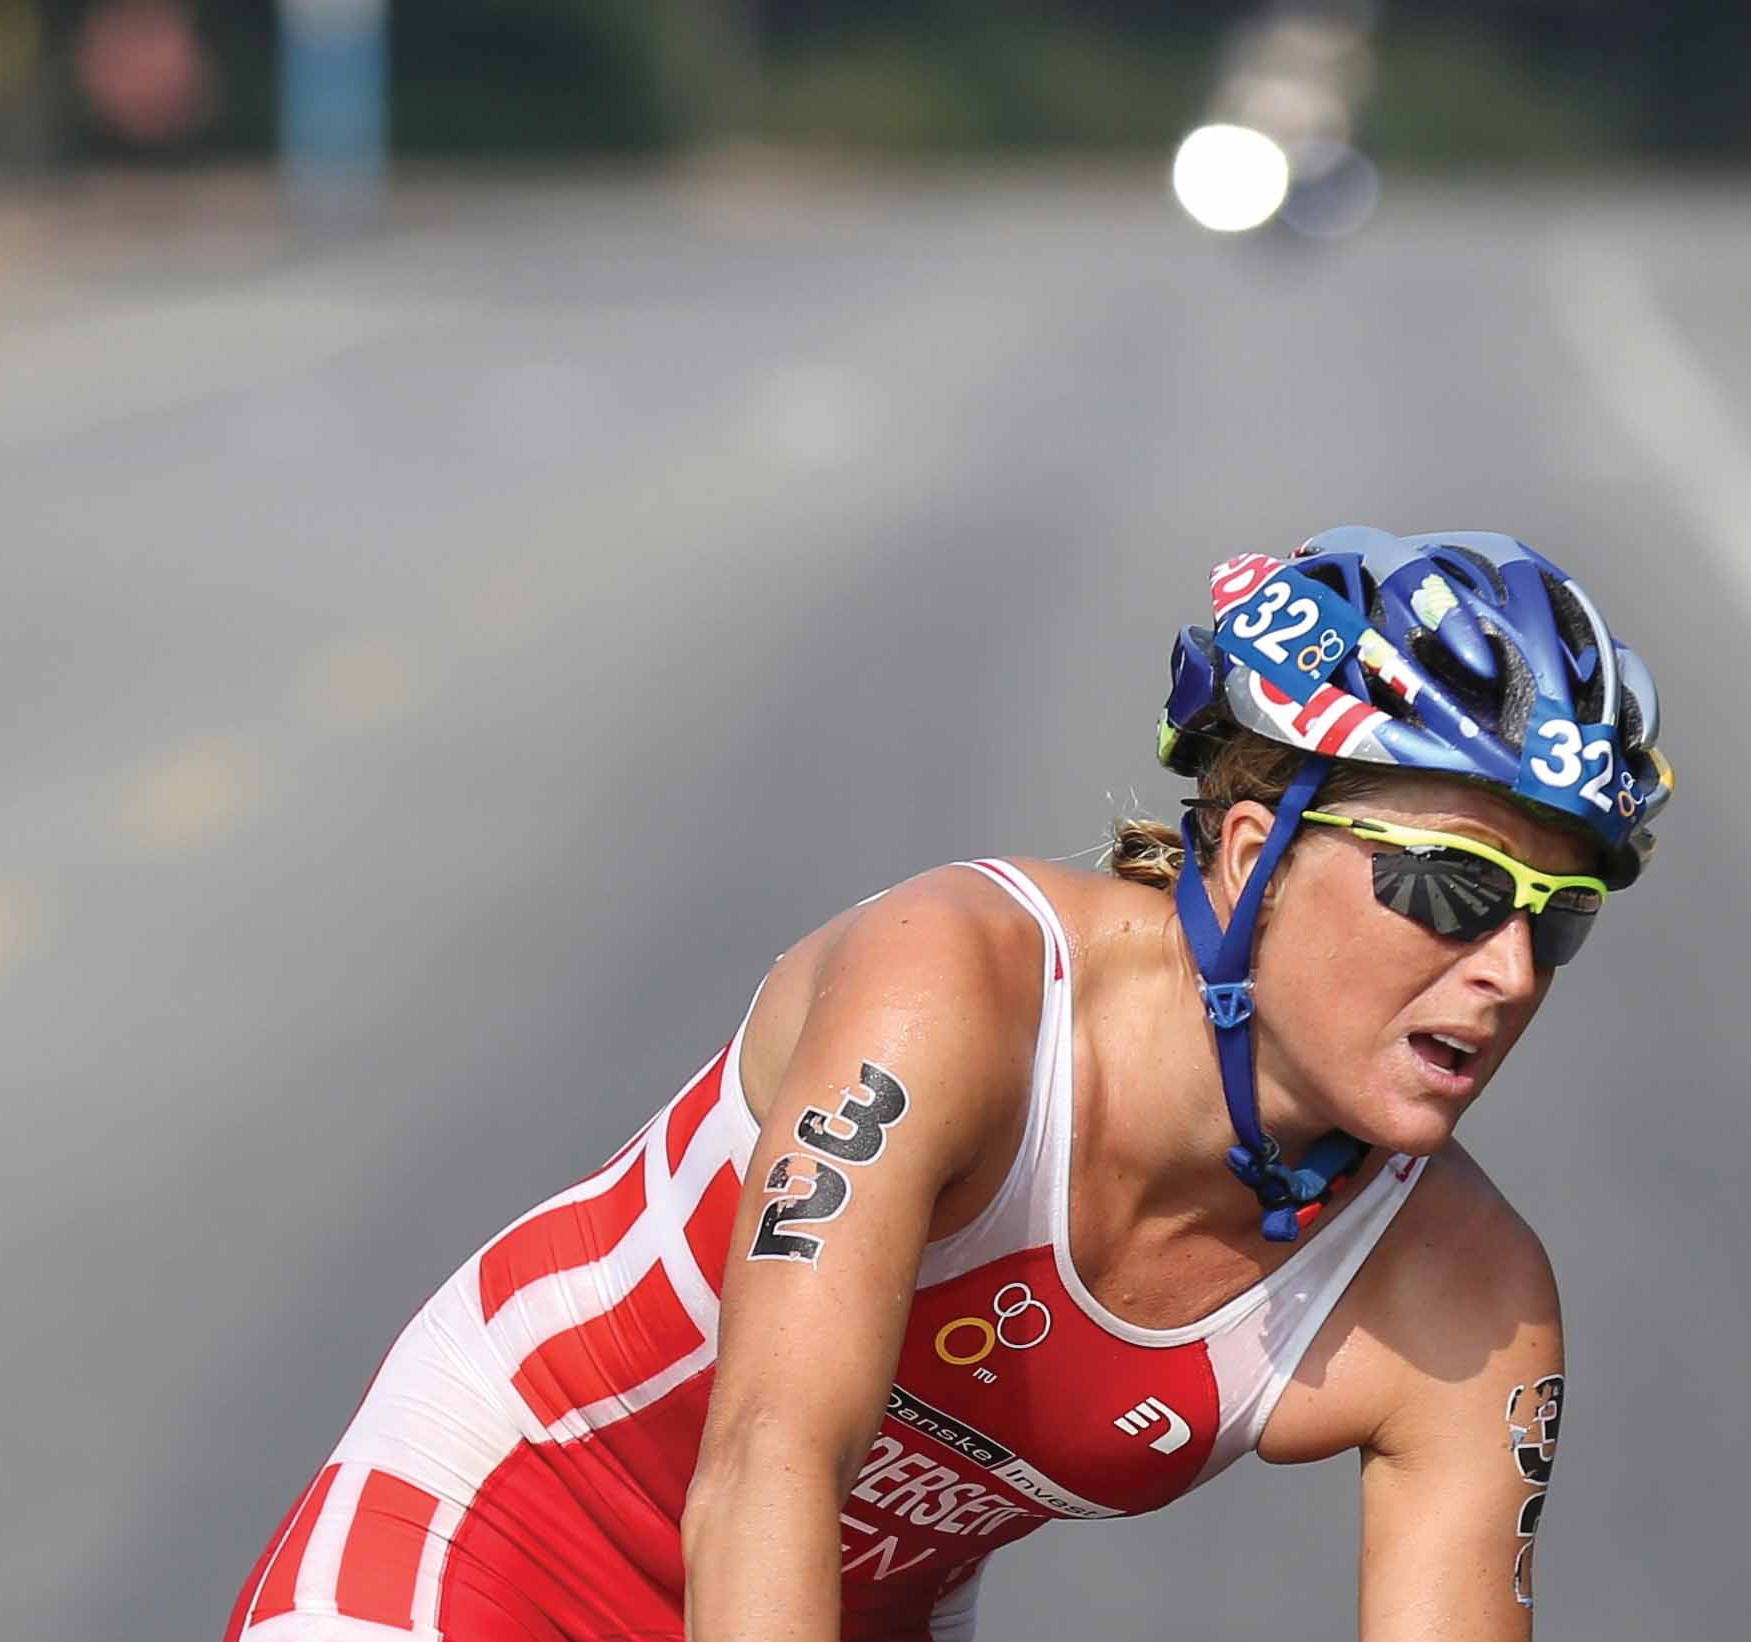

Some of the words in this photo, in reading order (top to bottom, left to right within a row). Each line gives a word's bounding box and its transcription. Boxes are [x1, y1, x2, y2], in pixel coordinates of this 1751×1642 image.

[1232, 582, 1319, 664] 32
[1530, 719, 1613, 813] 32
[746, 1058, 910, 1269] 32
[972, 1367, 998, 1384] ITU
[1006, 1469, 1100, 1518] Invest
